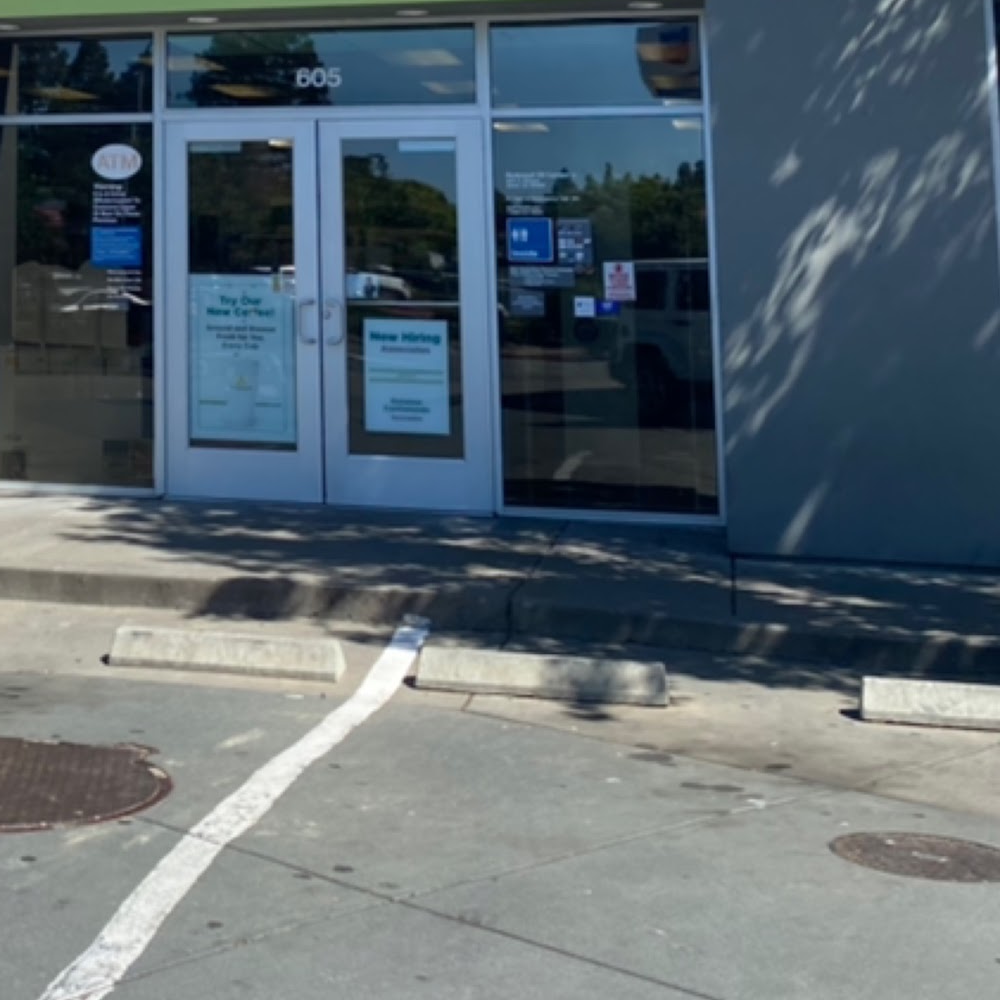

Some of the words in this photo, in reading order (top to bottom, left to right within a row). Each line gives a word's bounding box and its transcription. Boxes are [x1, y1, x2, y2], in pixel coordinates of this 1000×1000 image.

[295, 67, 343, 88] 605
[98, 153, 139, 169] ATM
[401, 331, 442, 346] Hiring
